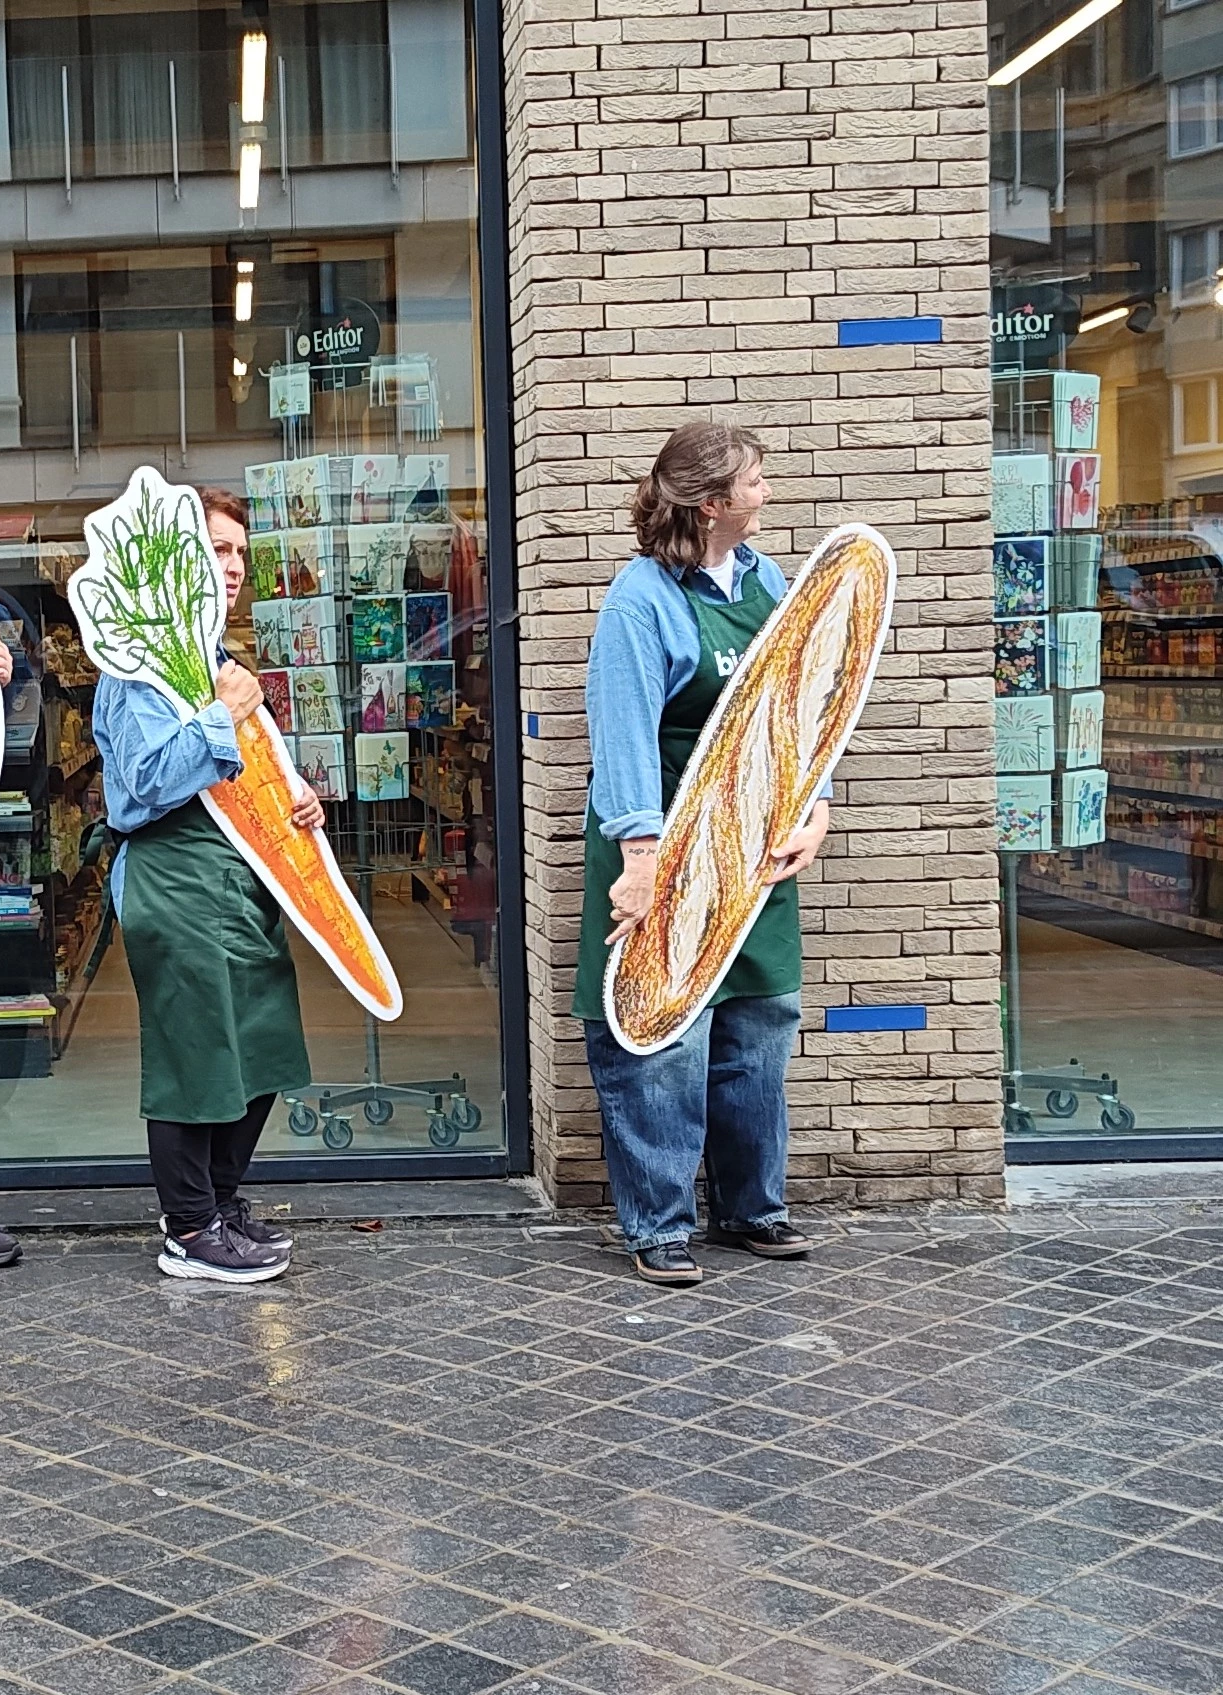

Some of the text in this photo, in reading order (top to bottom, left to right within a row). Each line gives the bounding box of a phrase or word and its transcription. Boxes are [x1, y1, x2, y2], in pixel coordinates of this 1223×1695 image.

[989, 312, 1054, 337] ditor
[1009, 332, 1047, 342] EMOTION
[313, 326, 364, 353] Editor
[713, 647, 745, 677] bi
[165, 1237, 187, 1259] HOKA
